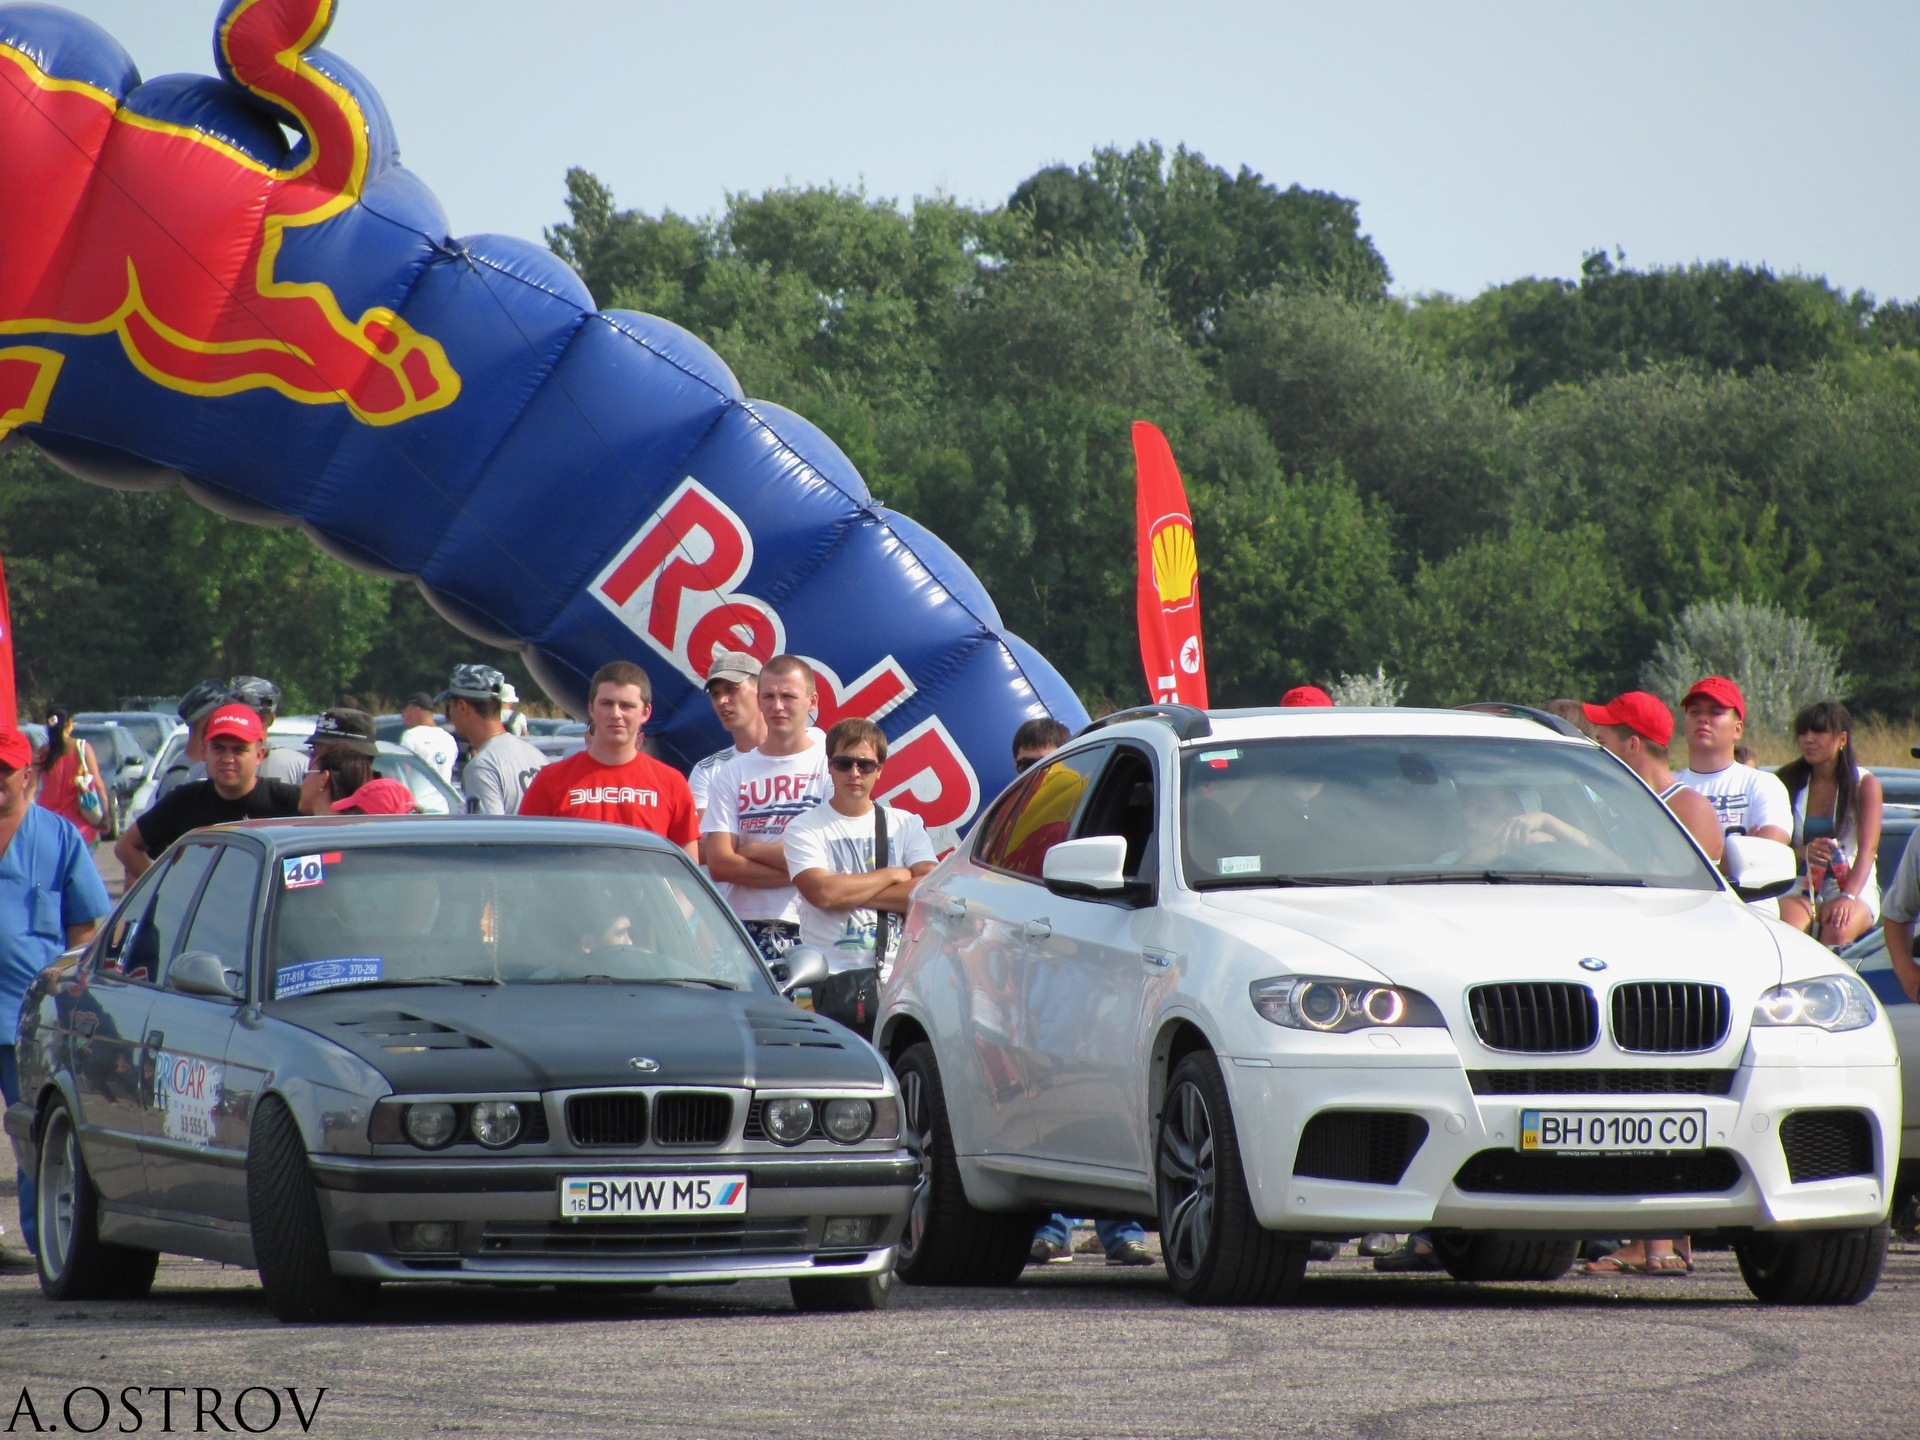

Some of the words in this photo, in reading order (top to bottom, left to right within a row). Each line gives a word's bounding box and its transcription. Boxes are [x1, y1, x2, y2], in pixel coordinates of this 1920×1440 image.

[569, 787, 658, 807] DUCATI
[286, 861, 321, 882] 40
[1525, 1136, 1538, 1144] UA
[1541, 1117, 1583, 1144] BH
[1589, 1117, 1653, 1144] 0100
[1659, 1116, 1698, 1144] CO
[571, 1199, 587, 1211] 16
[588, 1180, 666, 1211] BMW
[672, 1180, 712, 1210] M5
